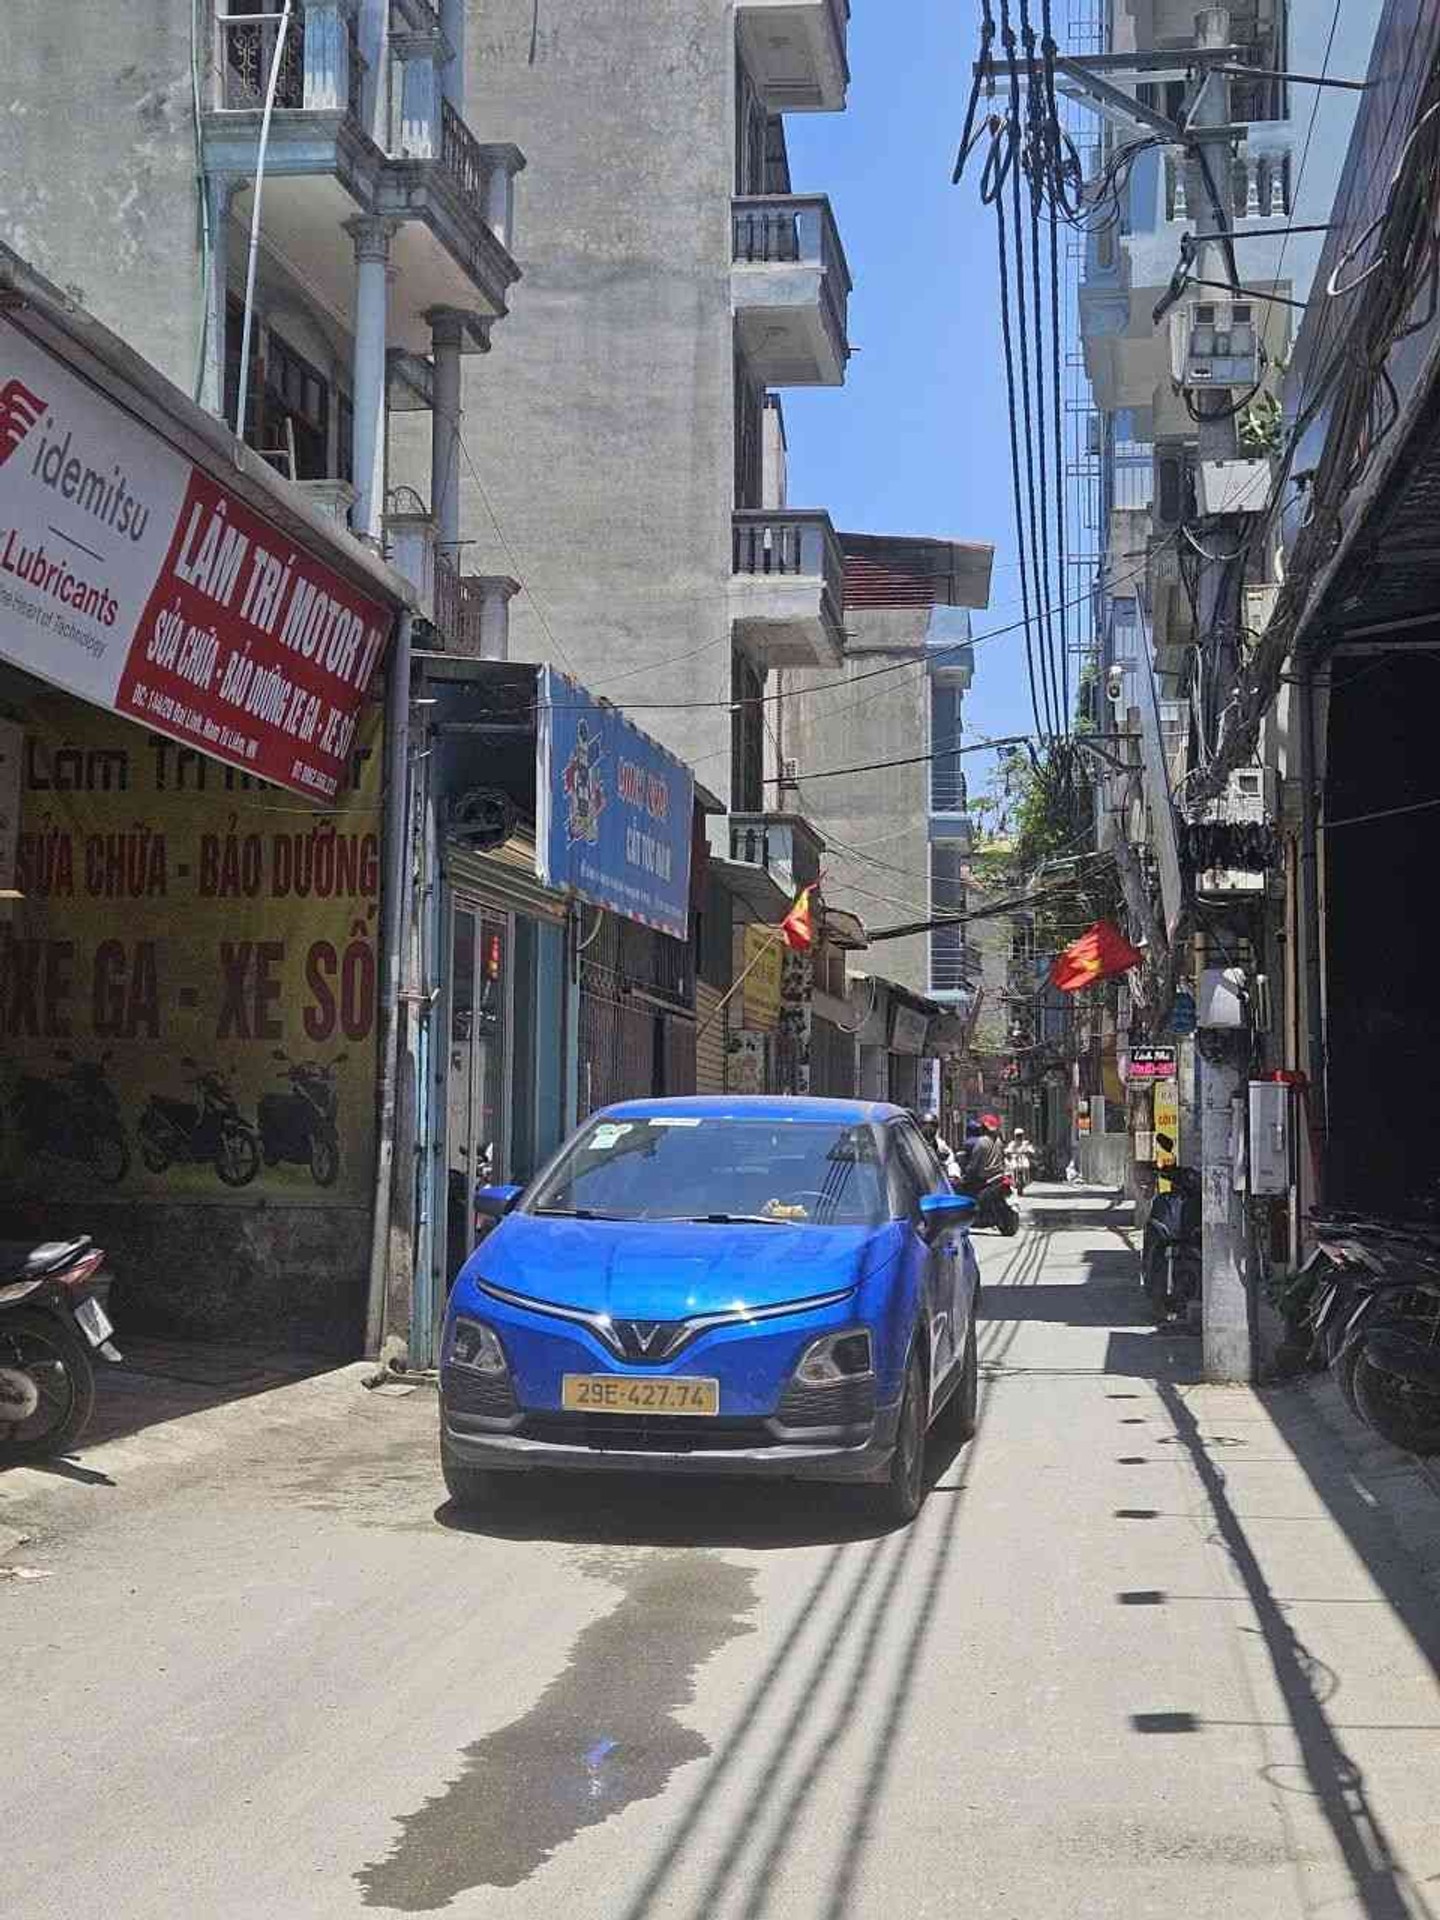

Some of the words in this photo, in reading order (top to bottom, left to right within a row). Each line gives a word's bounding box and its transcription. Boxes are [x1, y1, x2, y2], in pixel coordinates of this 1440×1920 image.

[31, 416, 150, 541] idemitsu
[1, 529, 119, 627] Lubricants
[174, 499, 250, 607] LÂM
[240, 545, 296, 635] TRÍ
[279, 576, 364, 682] MOTOR
[283, 686, 308, 736] XE
[274, 817, 378, 898] DƯỠNG
[217, 940, 284, 1040] XE
[304, 903, 376, 1042] SỐ
[577, 1382, 704, 1408] 29E-427.74
